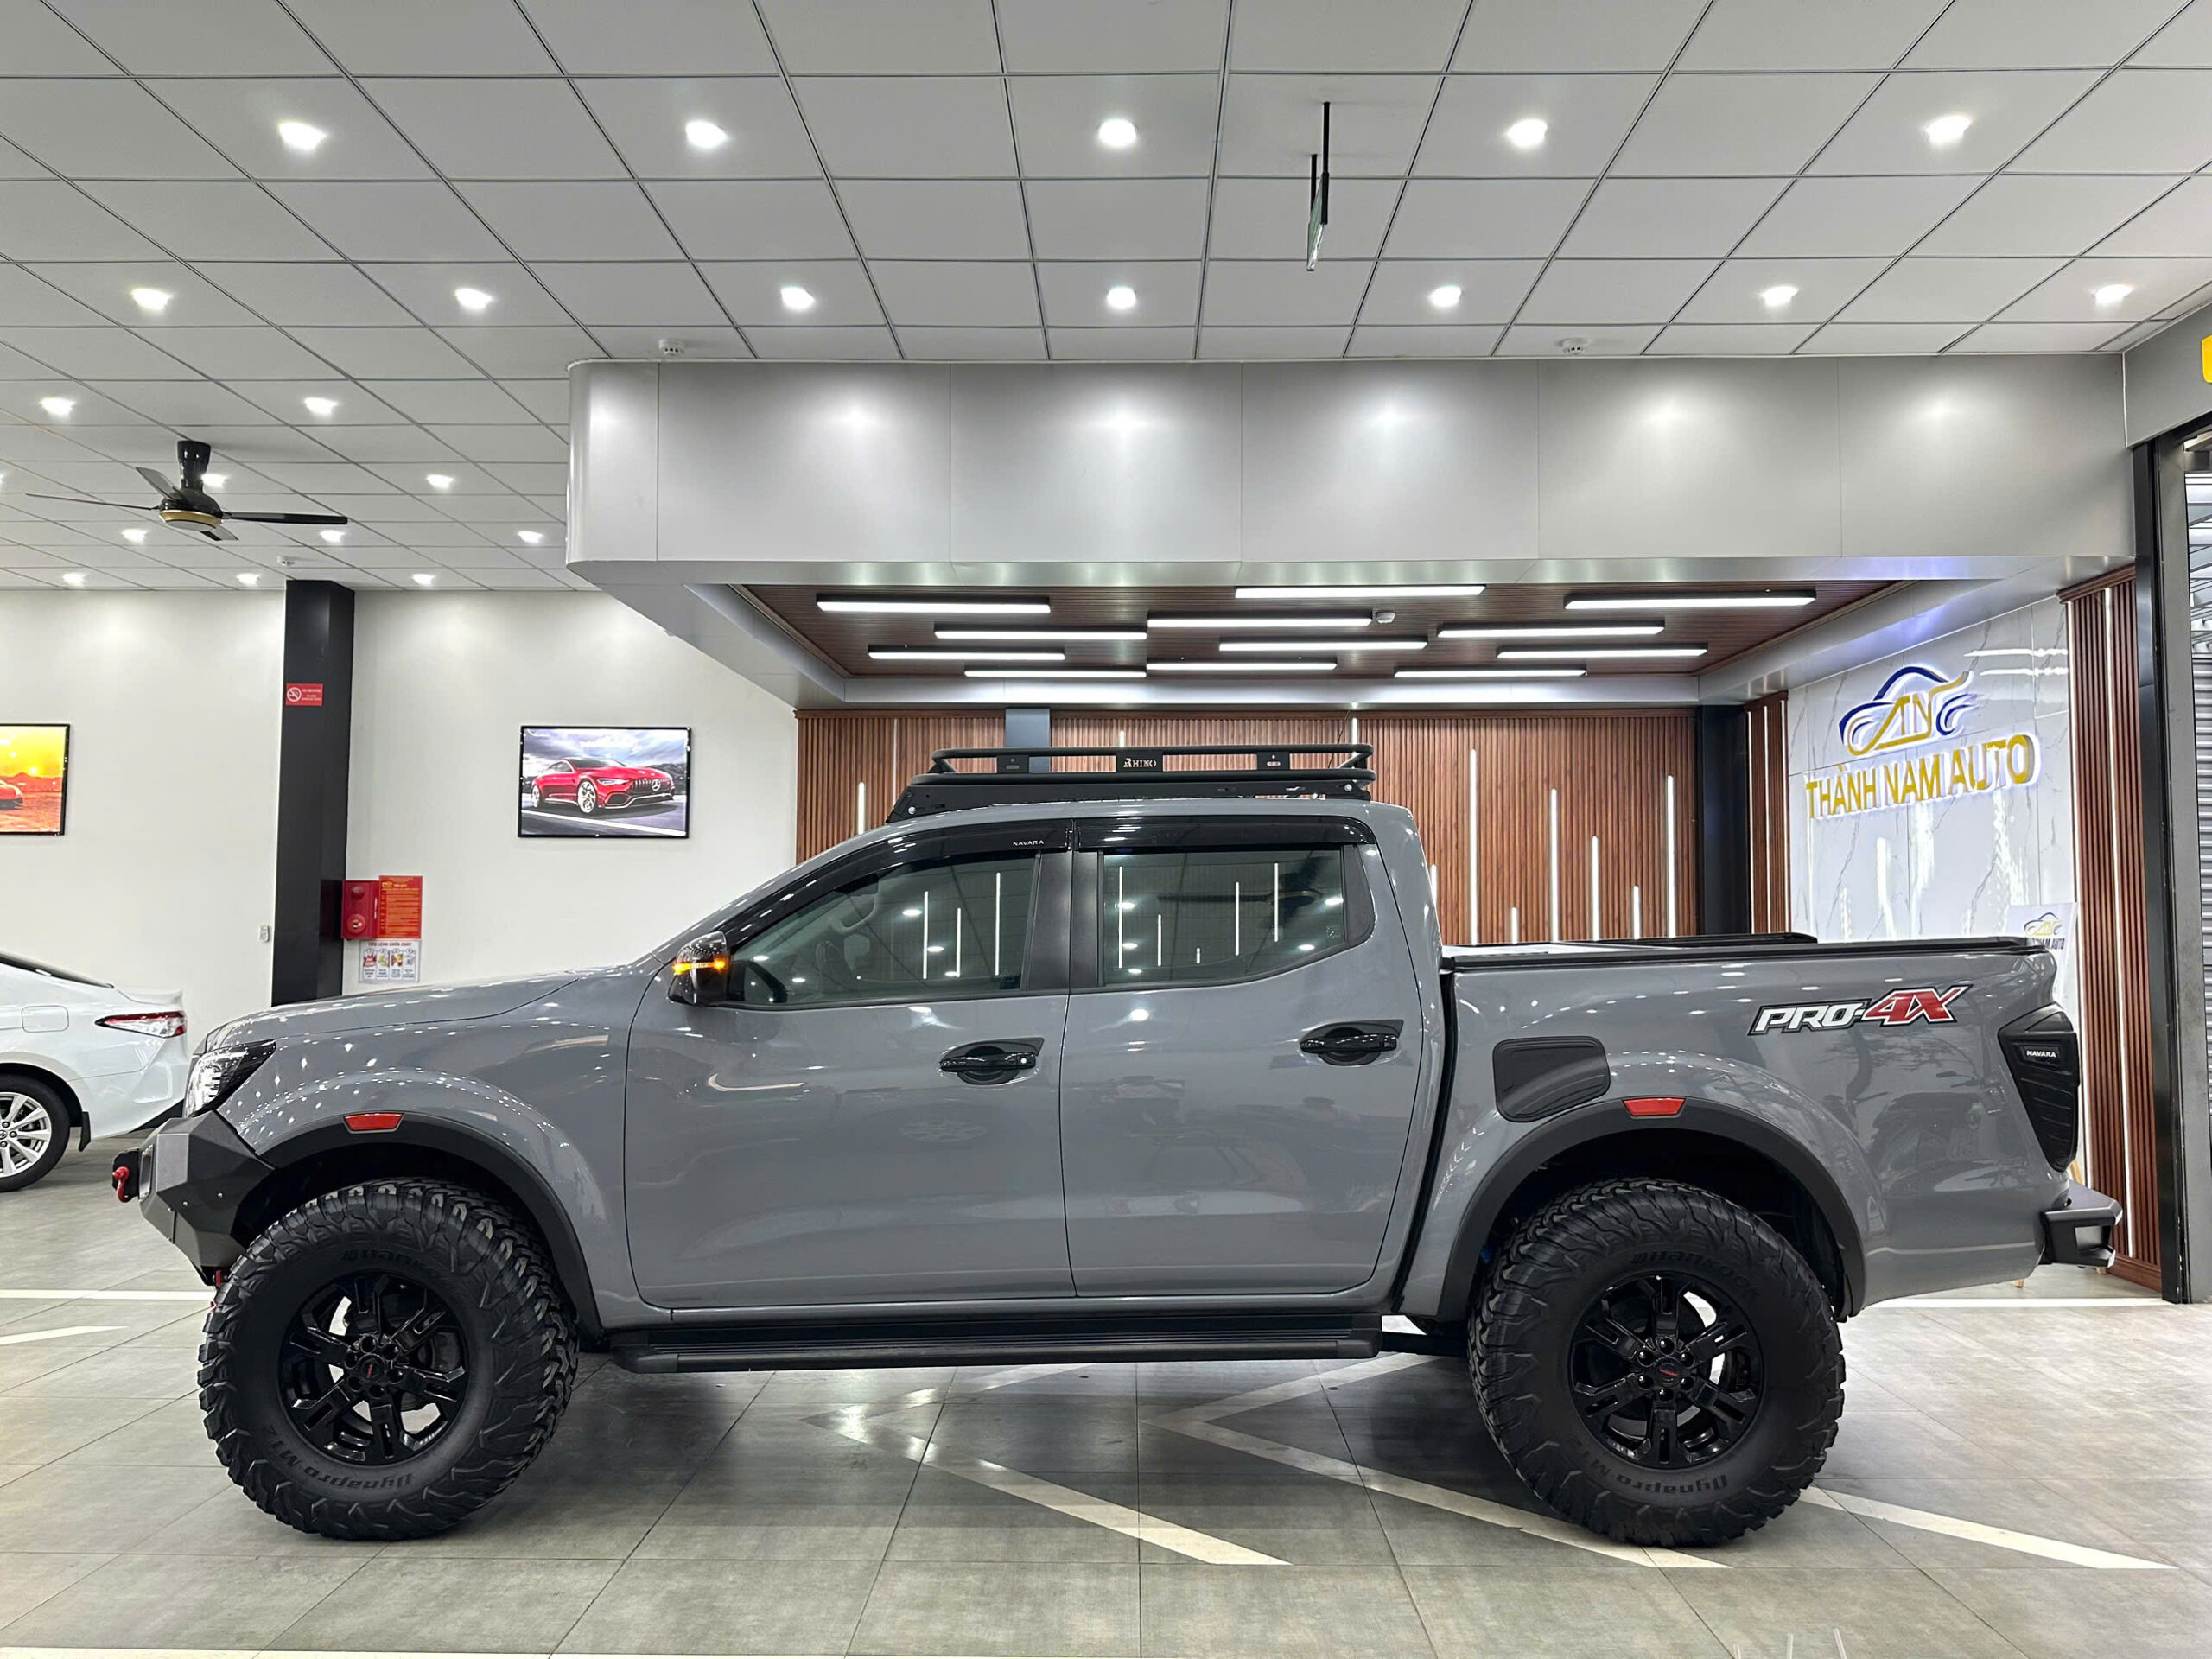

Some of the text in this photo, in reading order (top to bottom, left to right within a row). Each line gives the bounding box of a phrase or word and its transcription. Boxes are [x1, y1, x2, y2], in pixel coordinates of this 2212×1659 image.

[1805, 734, 2036, 818] THÀNH NAM AUTO
[1748, 984, 1973, 1035] PRO-4X
[2025, 1050, 2057, 1058] NAVARA
[303, 1465, 414, 1490] Dynapro
[1616, 1473, 1729, 1494] Dynapro
